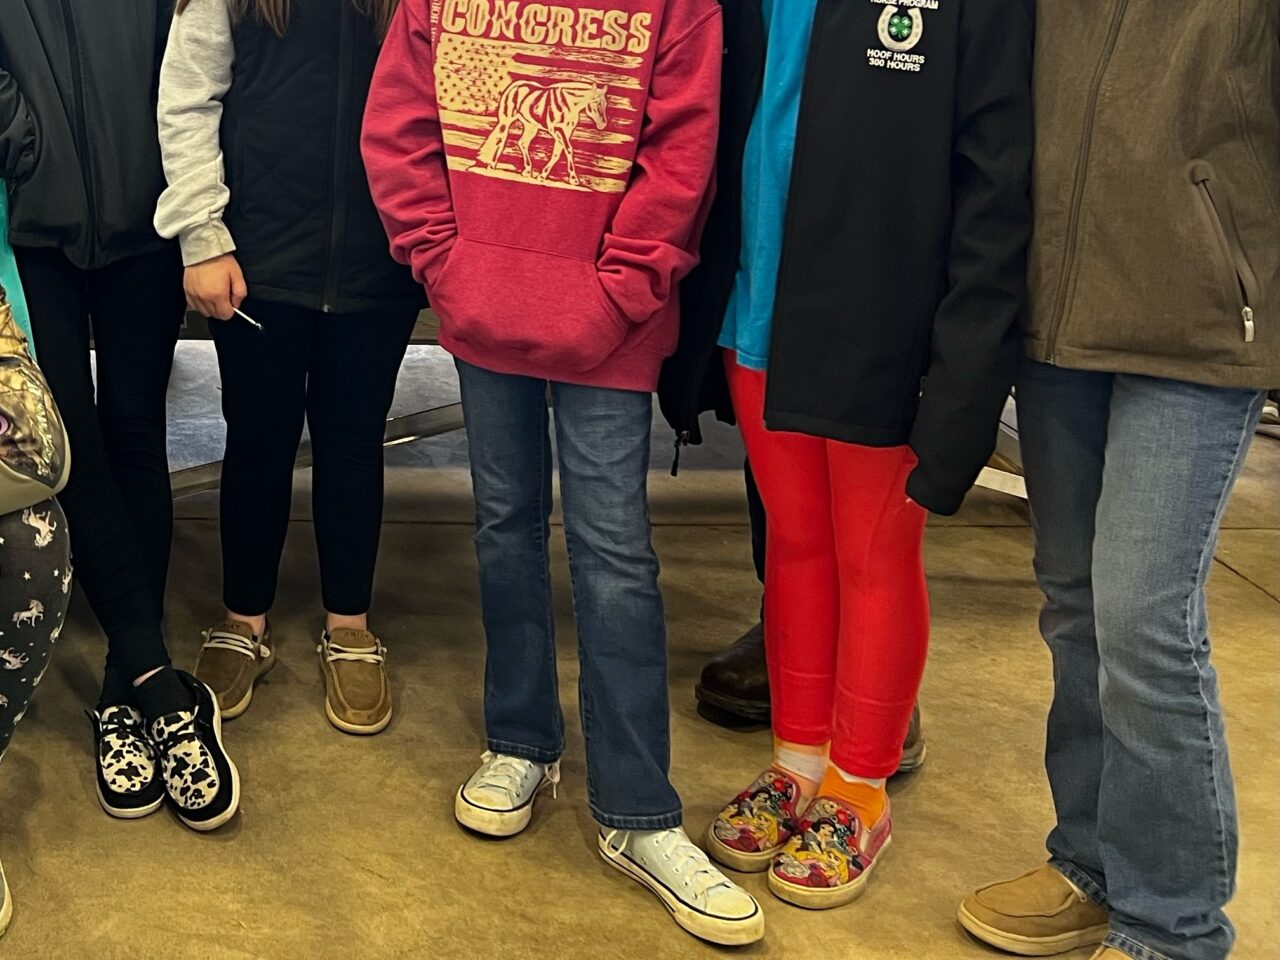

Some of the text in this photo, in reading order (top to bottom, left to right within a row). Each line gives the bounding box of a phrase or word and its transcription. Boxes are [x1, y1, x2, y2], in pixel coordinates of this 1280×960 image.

[866, 48, 926, 64] HOOF HOURS
[868, 57, 921, 72] 300 HOURS
